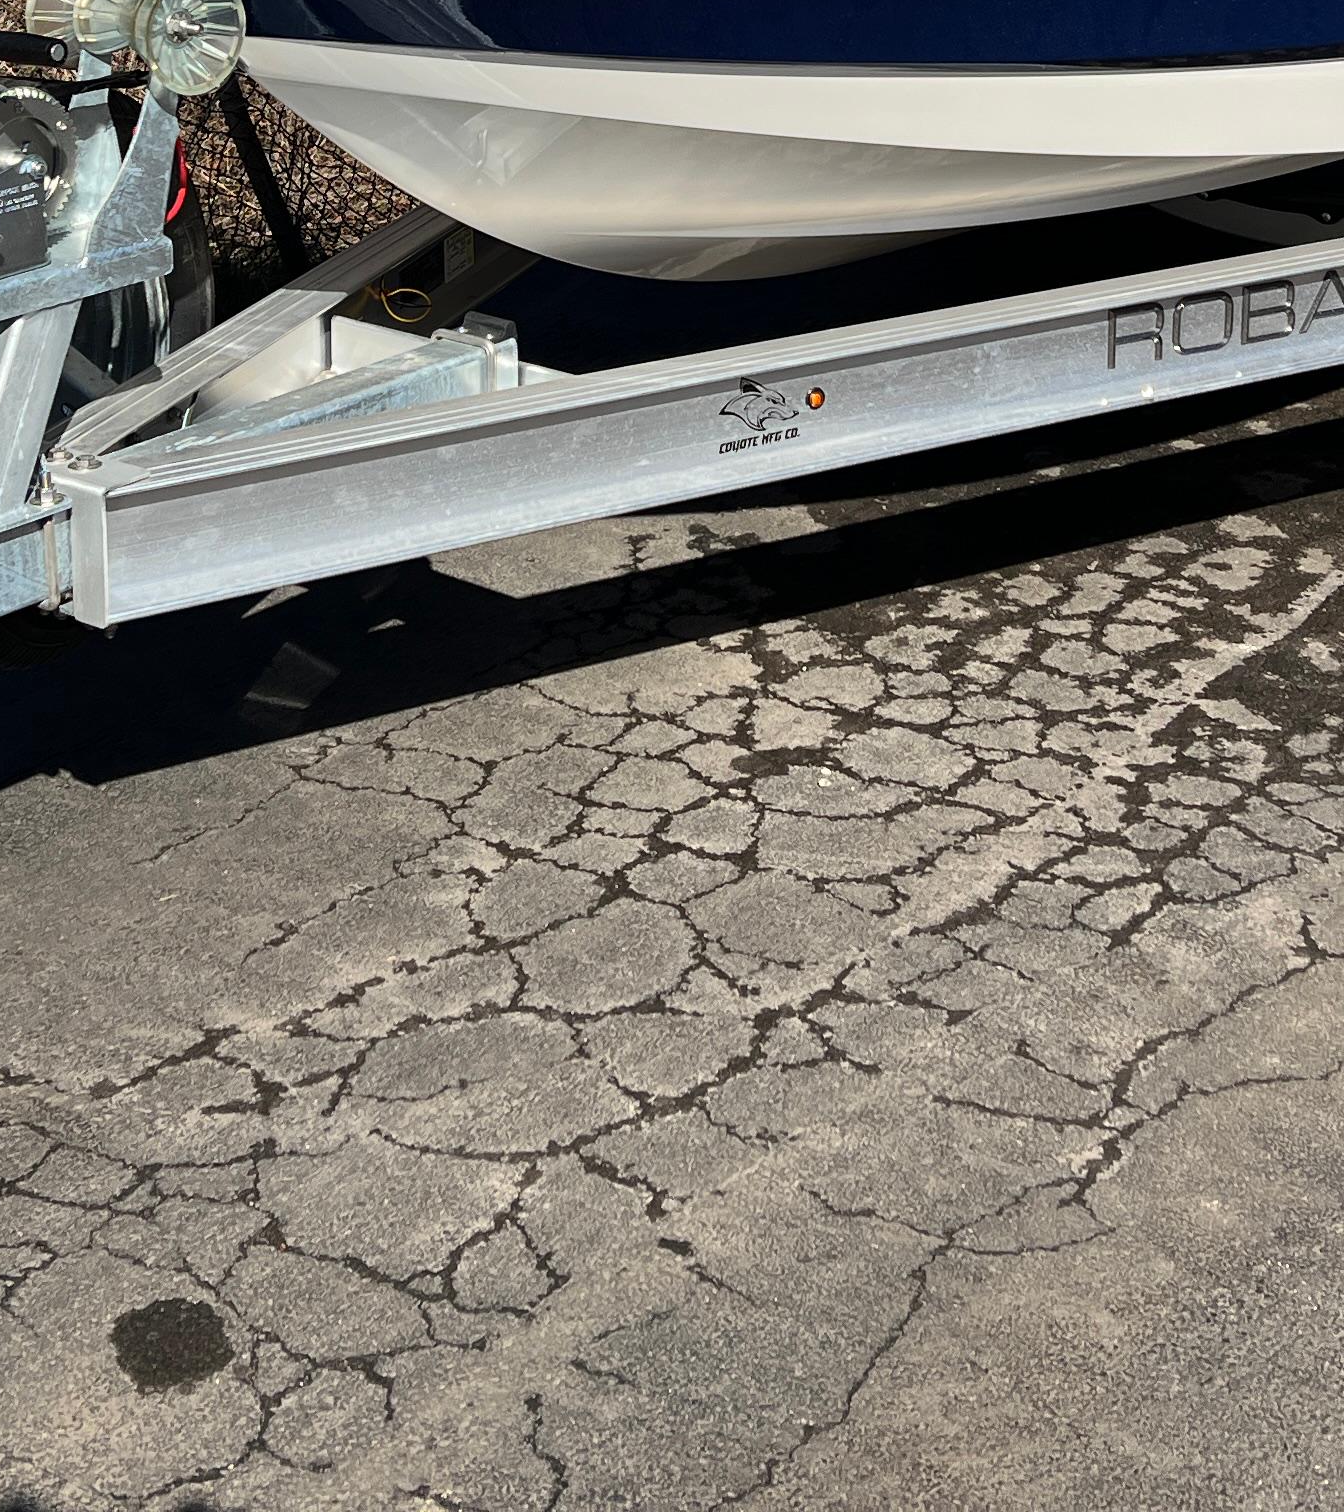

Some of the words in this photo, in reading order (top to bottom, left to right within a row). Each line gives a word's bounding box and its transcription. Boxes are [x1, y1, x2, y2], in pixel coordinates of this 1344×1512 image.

[718, 436, 760, 454] COYOTE
[761, 430, 783, 445] MFG
[784, 427, 801, 439] CO.
